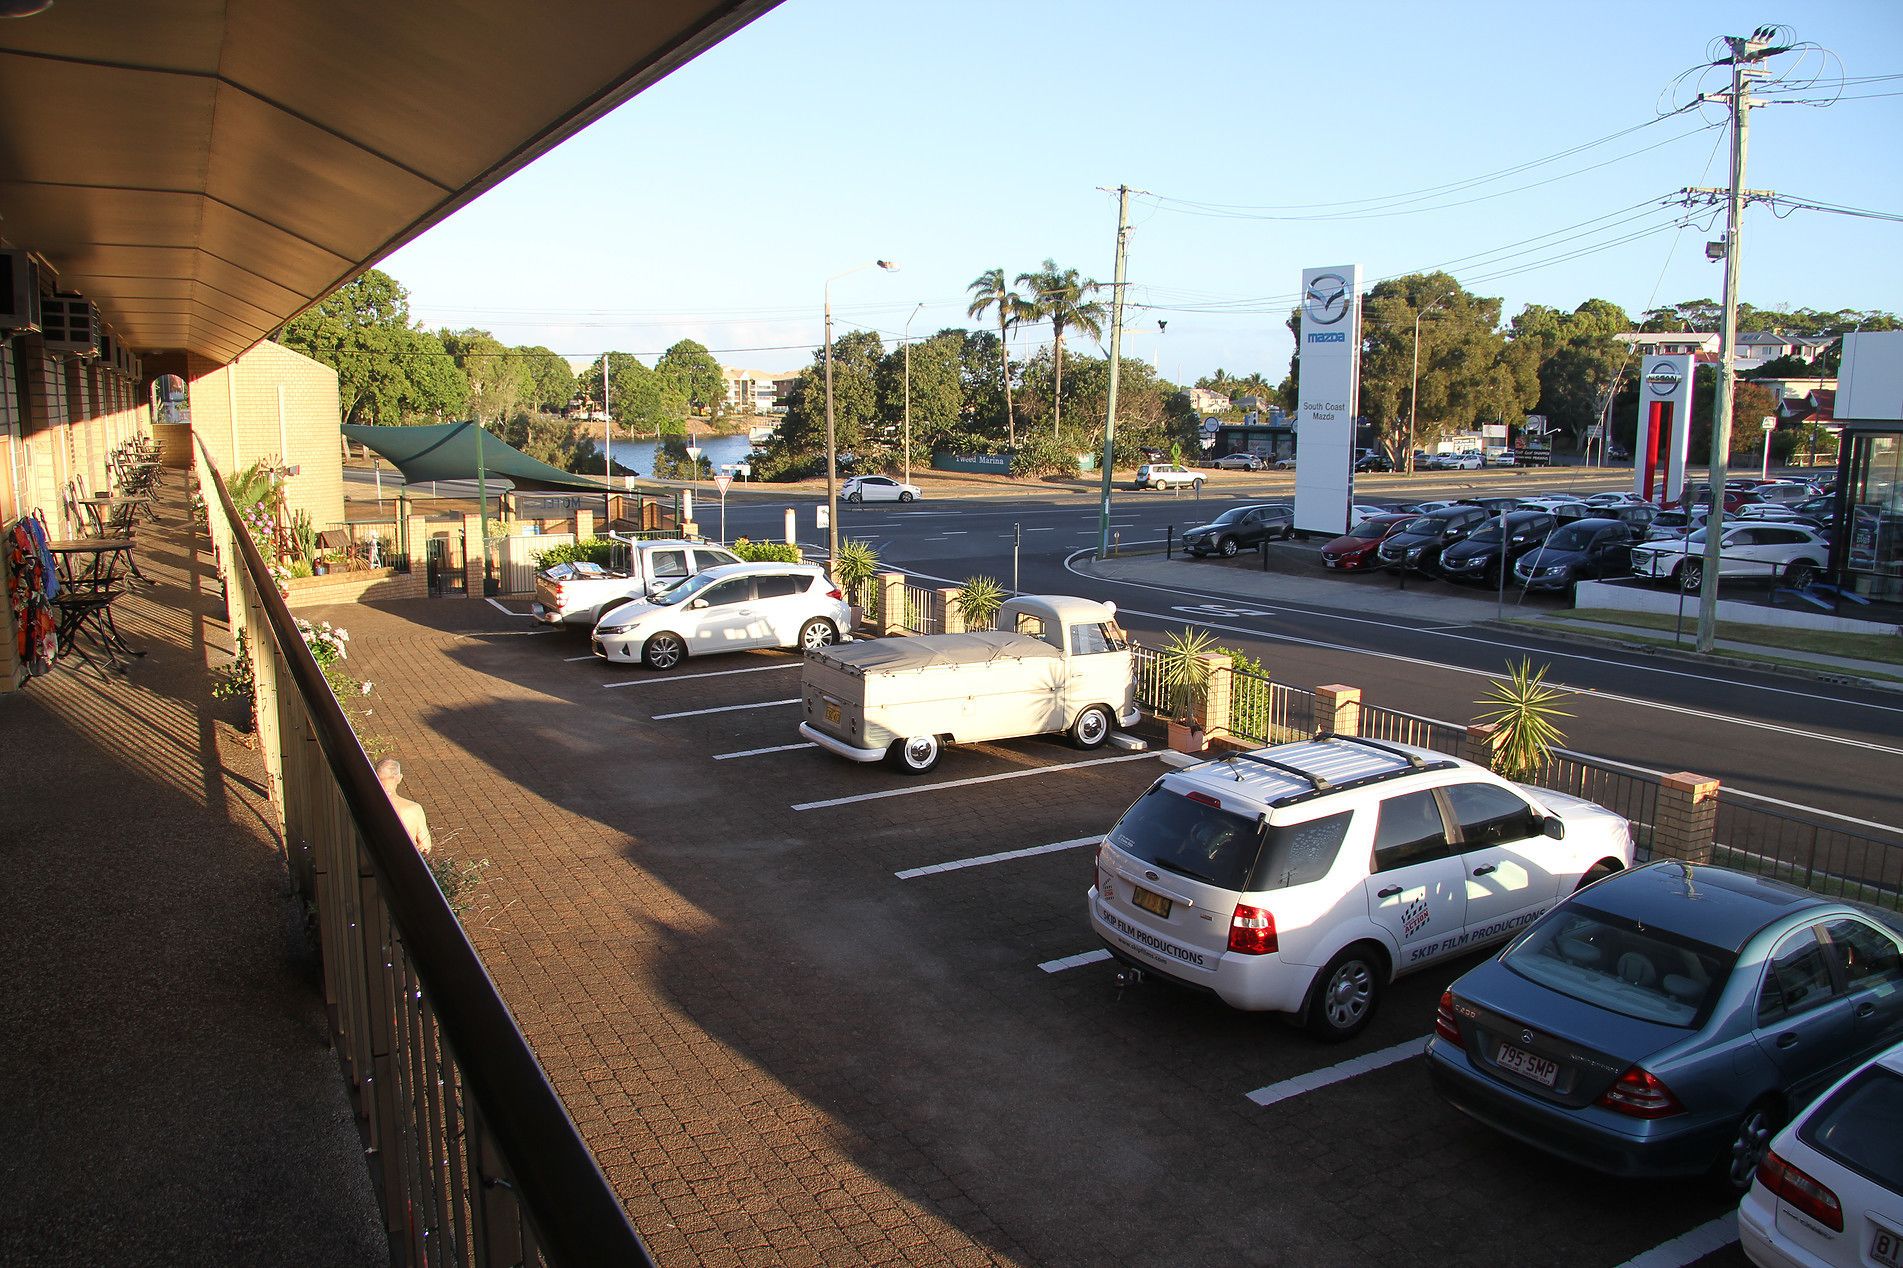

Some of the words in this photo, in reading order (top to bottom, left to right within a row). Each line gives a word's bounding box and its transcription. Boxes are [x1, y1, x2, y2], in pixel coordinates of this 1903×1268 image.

[1308, 332, 1345, 343] mazda
[1303, 402, 1323, 411] South
[1325, 402, 1345, 411] Coast
[1312, 412, 1335, 421] Mazda
[979, 456, 1004, 465] Marina
[1404, 910, 1430, 934] ACTION
[1103, 909, 1118, 928] SKIP
[1117, 919, 1136, 938] FILM
[1136, 927, 1204, 966] PRODUCTIONS
[1410, 943, 1439, 962] SKIP
[1441, 933, 1470, 952] FILM
